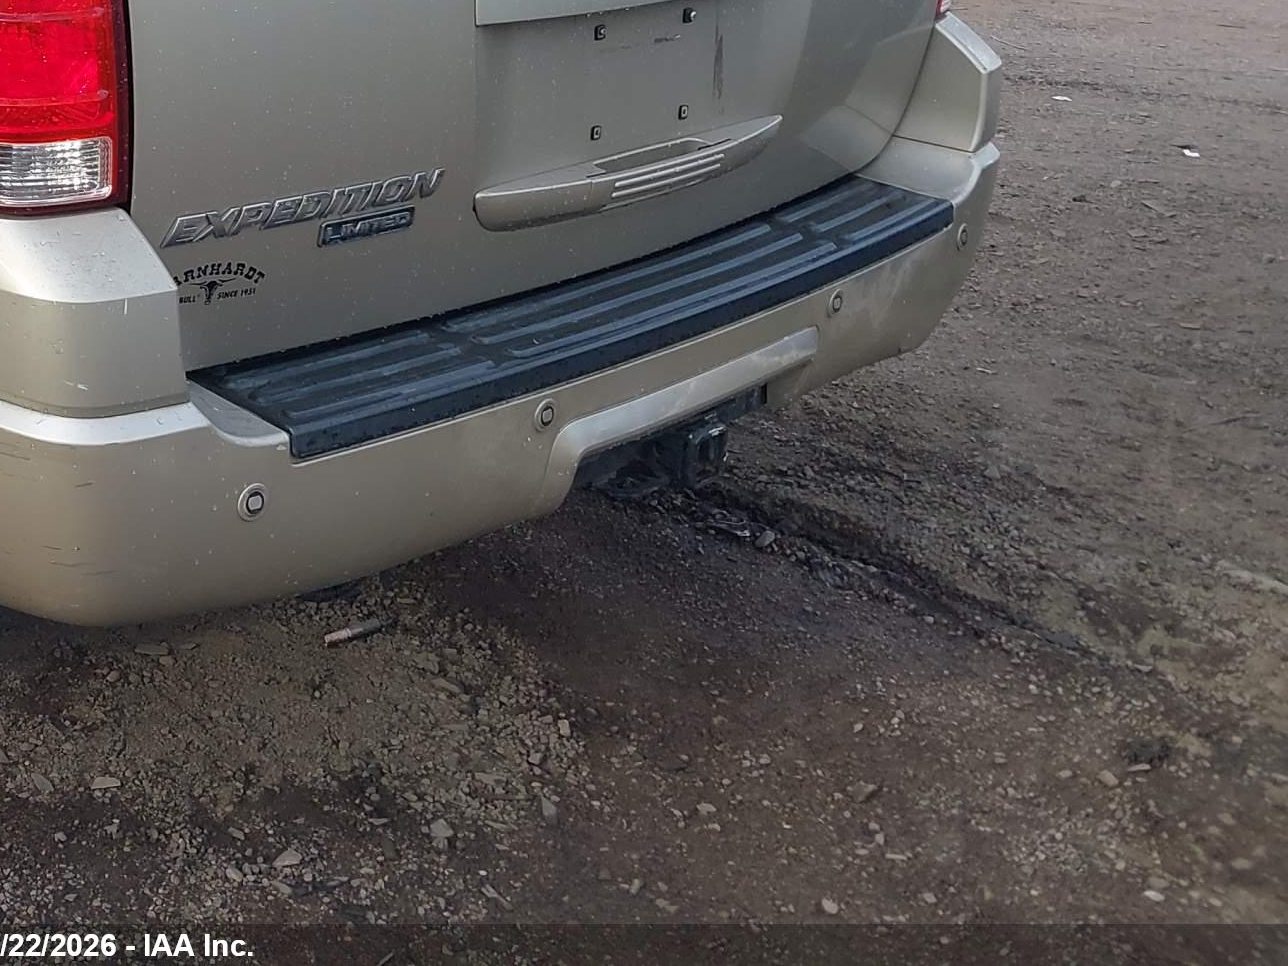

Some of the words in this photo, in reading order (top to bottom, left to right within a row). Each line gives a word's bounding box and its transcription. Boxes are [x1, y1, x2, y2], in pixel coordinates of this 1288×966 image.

[160, 167, 445, 248] EXPEDITION
[325, 210, 411, 241] LIMITED
[216, 289, 239, 300] SINCE
